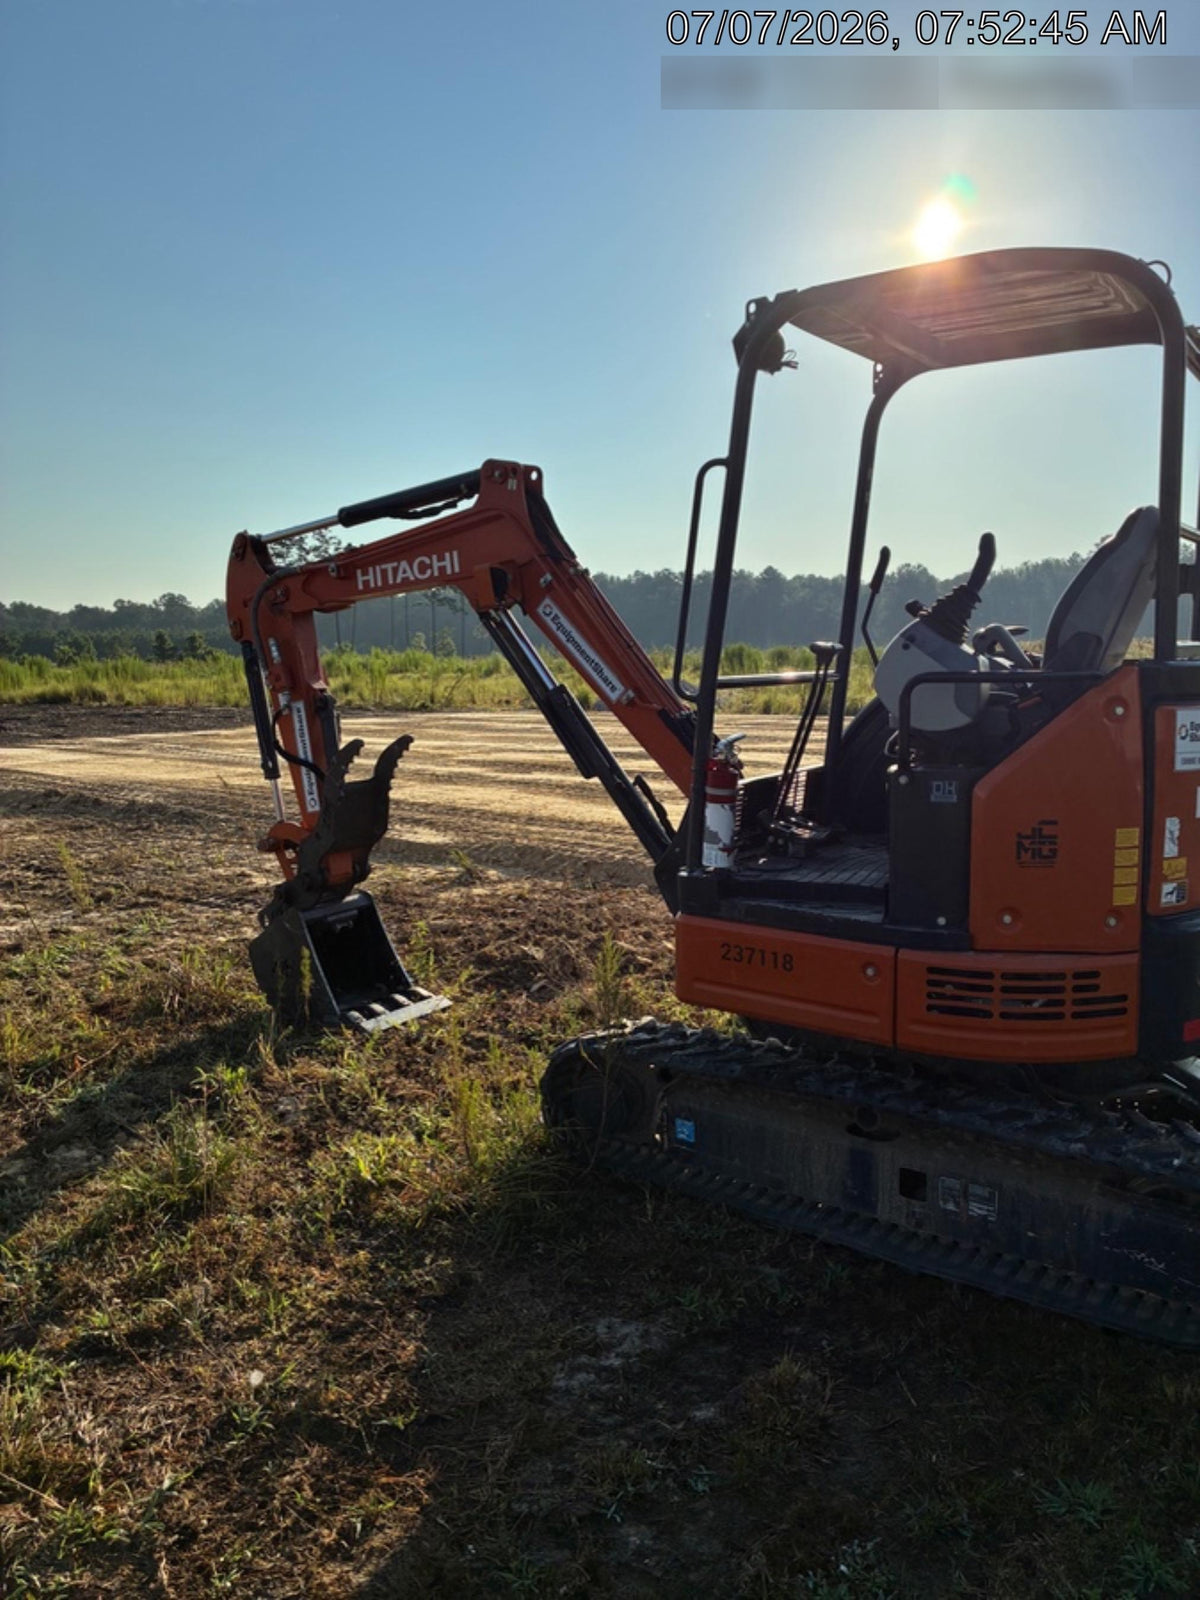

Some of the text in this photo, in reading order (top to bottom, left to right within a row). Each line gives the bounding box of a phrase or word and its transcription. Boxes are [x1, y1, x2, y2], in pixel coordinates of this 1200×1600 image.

[356, 550, 460, 590] HITACHI
[550, 614, 618, 694] EquipmentShare
[721, 942, 795, 973] 237118
